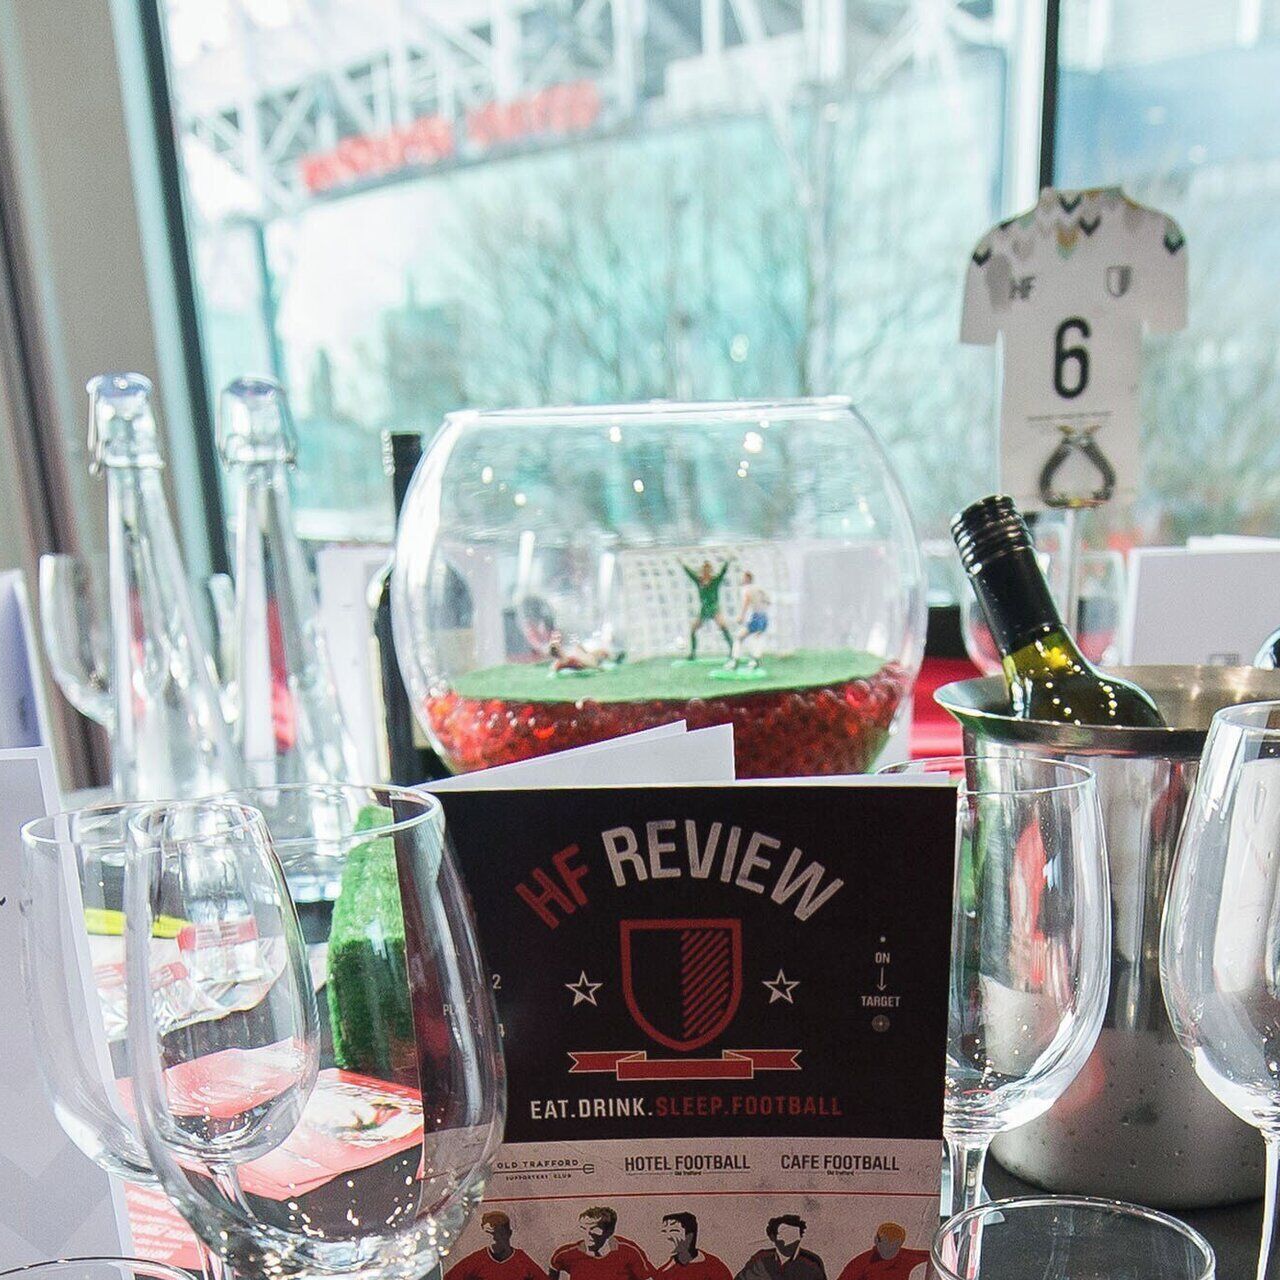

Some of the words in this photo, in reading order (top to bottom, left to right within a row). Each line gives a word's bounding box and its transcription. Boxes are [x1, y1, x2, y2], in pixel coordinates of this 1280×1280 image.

[1053, 314, 1091, 399] 6
[515, 843, 590, 929] HF
[600, 818, 844, 922] REVIEW
[875, 951, 890, 964] ON
[492, 973, 501, 989] 2
[861, 995, 901, 1007] TARGET
[497, 1161, 518, 1169] OLD
[523, 1159, 579, 1168] TRAFFORD
[625, 1156, 671, 1172] HOTEL
[674, 1154, 751, 1171] FOOTBALL
[781, 1154, 820, 1169] CAFE
[823, 1154, 900, 1171] FOOTBALL
